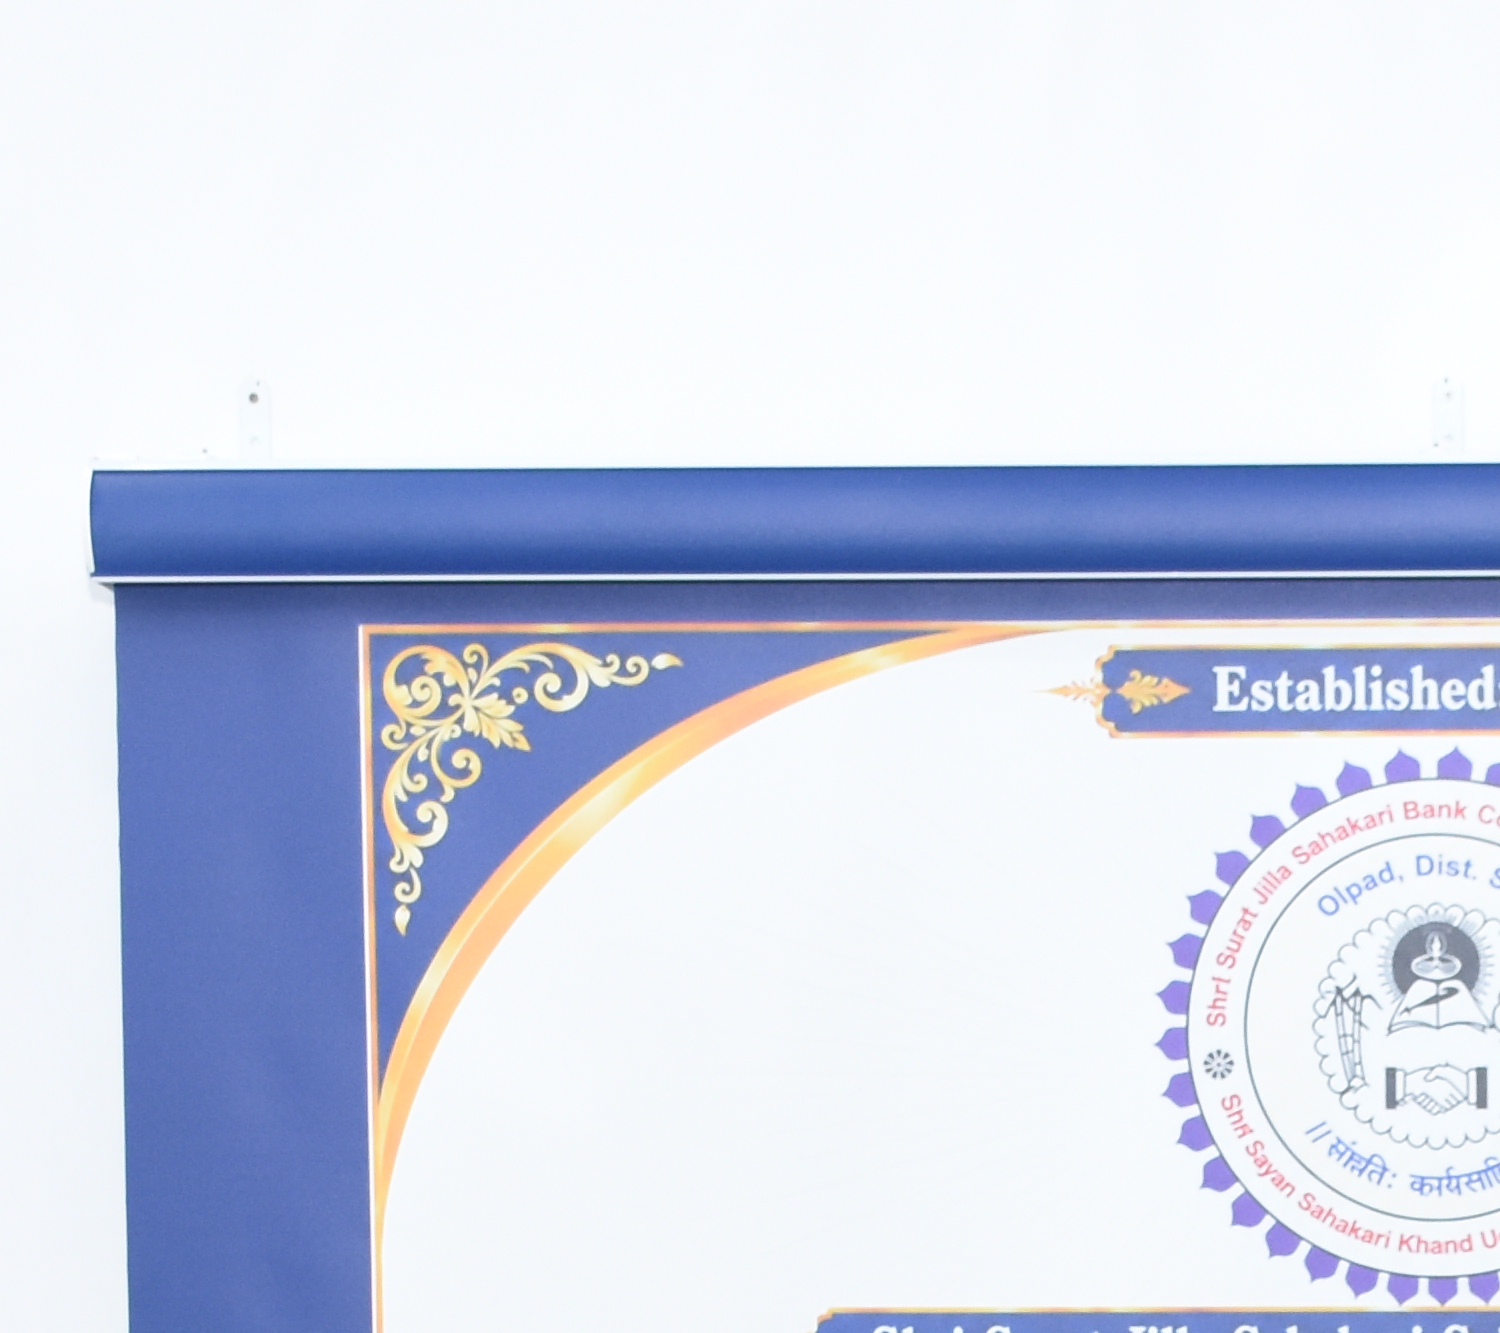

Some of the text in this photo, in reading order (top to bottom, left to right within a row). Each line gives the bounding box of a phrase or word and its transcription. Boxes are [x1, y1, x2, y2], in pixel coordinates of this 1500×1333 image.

[1291, 805, 1395, 865] Sahakari
[1403, 800, 1467, 820] Bank
[1254, 863, 1293, 905] Jilla
[1317, 863, 1404, 918] Olpad,
[1415, 854, 1477, 879] Dist.
[1216, 906, 1258, 968] Surat
[1206, 971, 1228, 1027] Shri
[1221, 1094, 1251, 1139] Shri
[1245, 1140, 1296, 1199] Sayan
[1297, 1190, 1393, 1249] Sahakari
[1399, 1234, 1474, 1255] Khand
